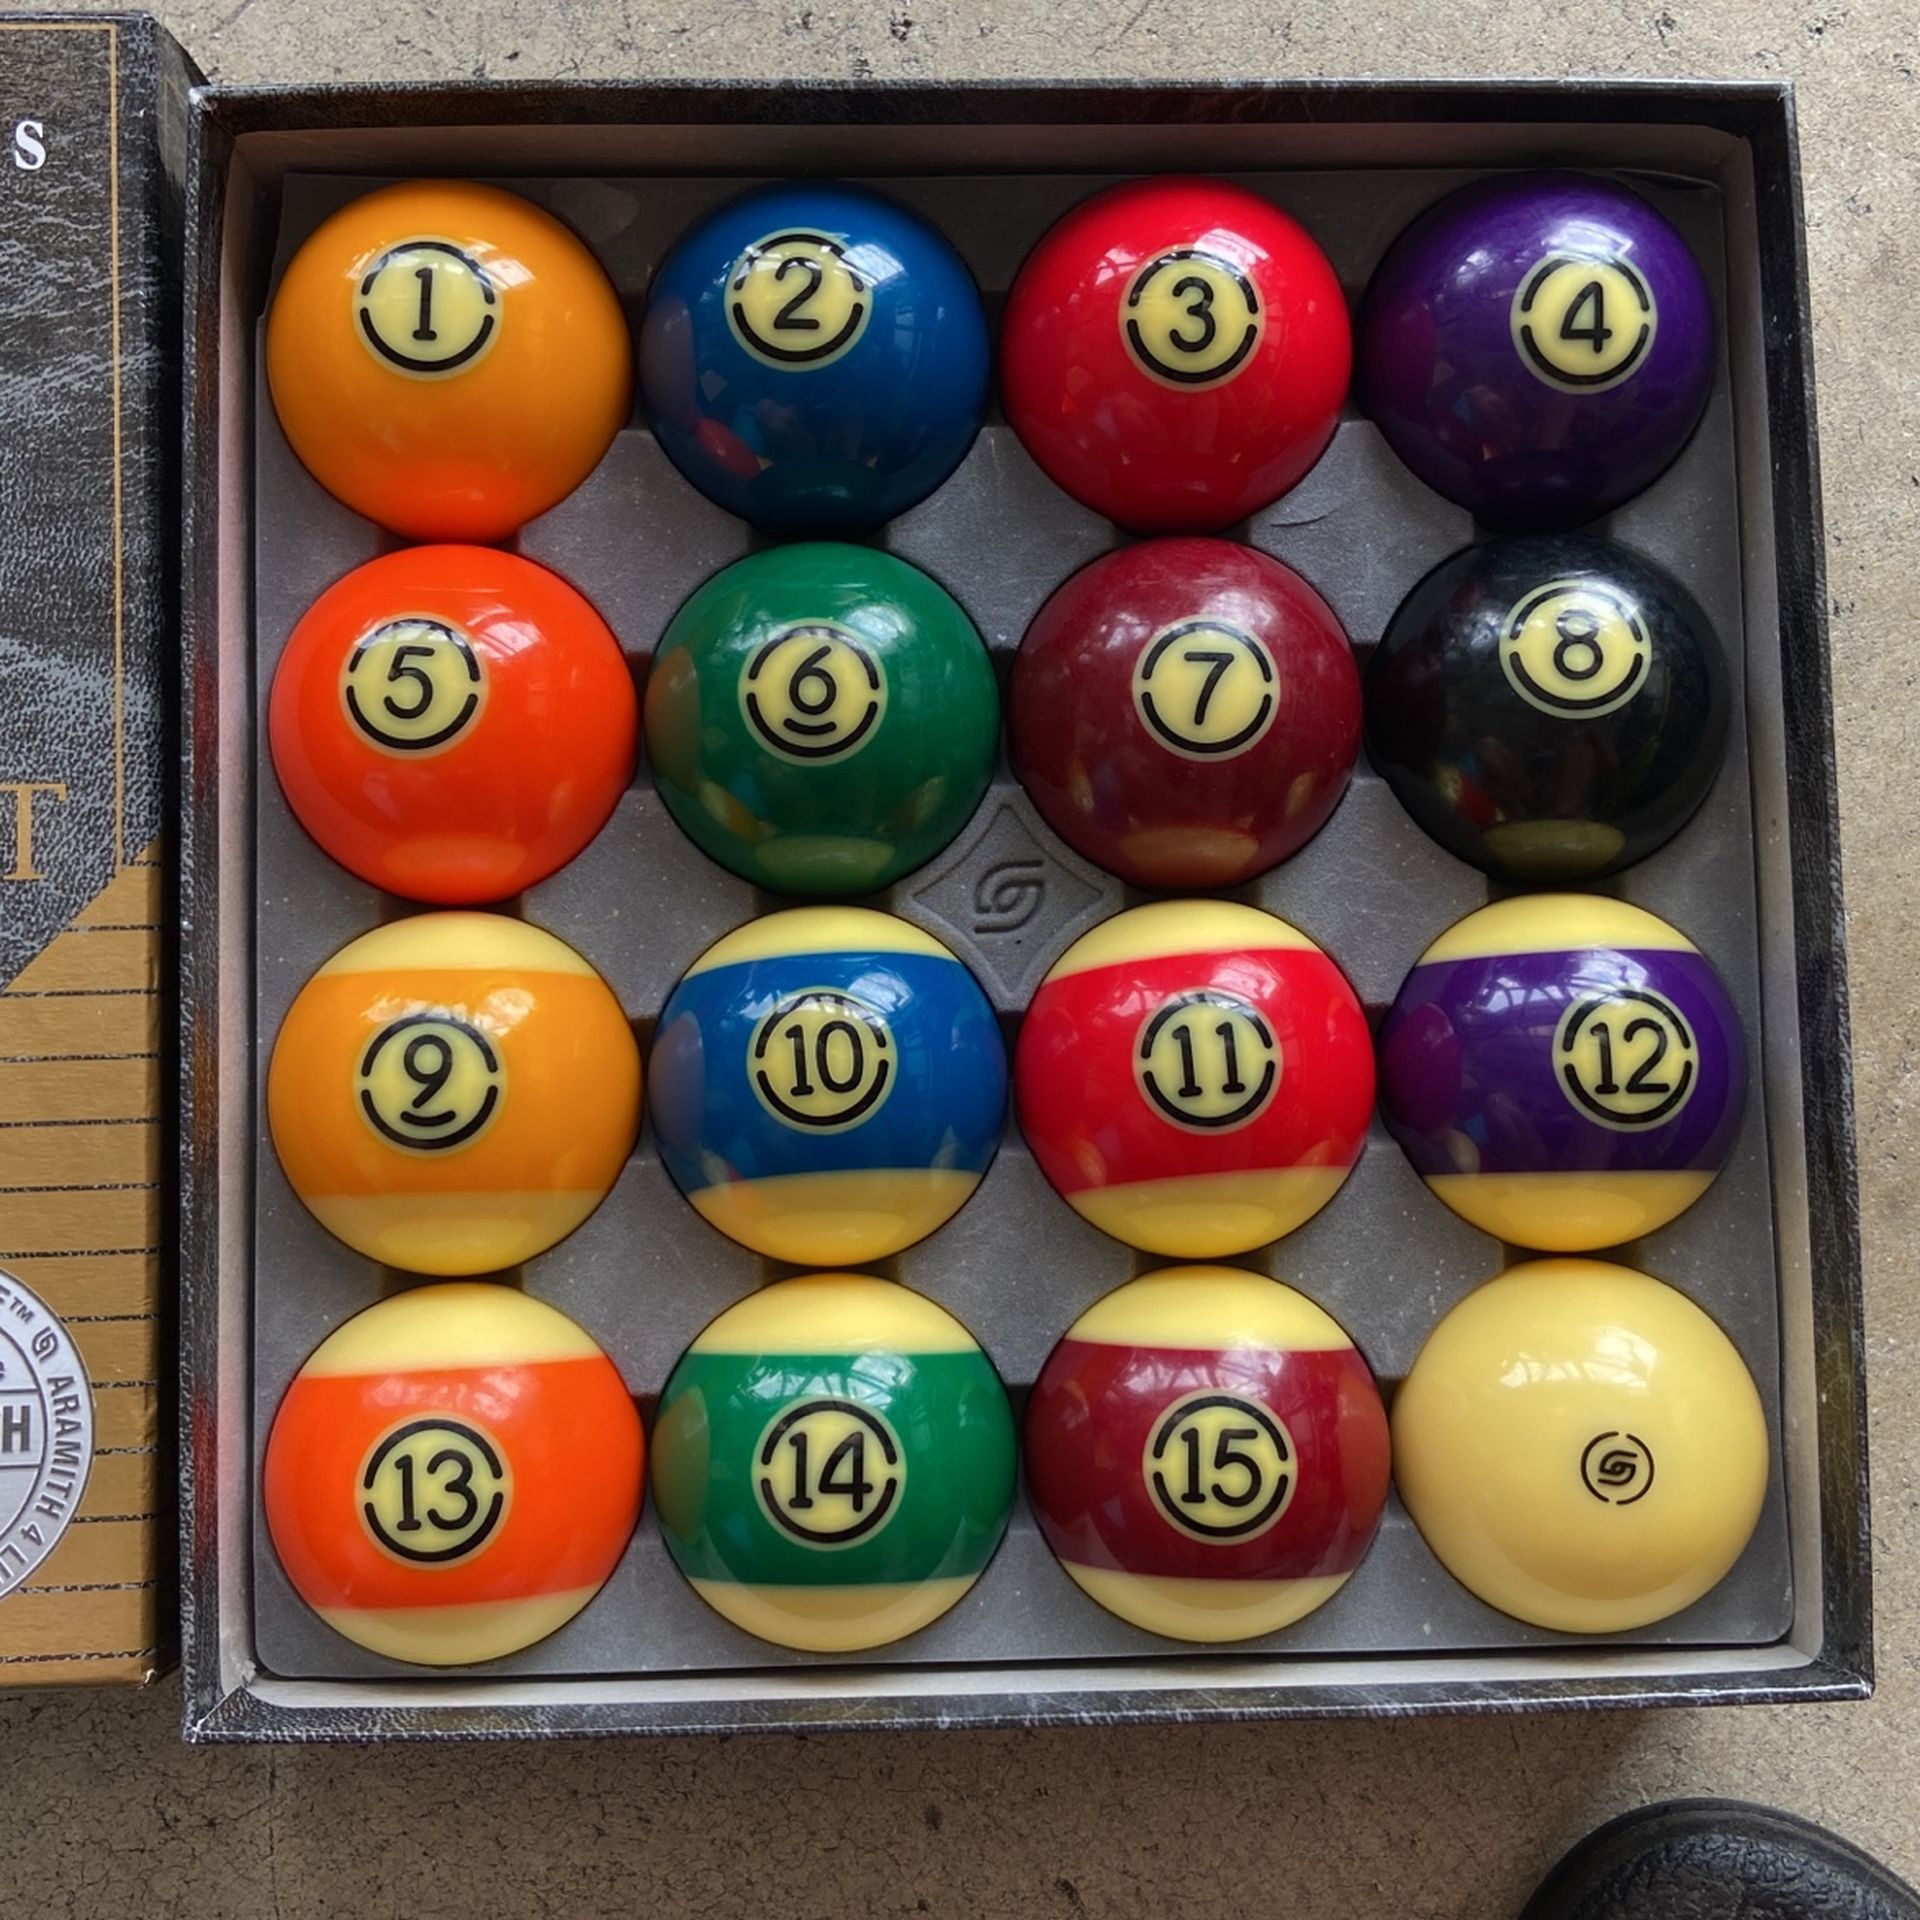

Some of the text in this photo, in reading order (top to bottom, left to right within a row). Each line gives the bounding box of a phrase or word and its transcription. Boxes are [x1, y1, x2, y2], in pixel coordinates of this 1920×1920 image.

[15, 121, 46, 170] S
[411, 267, 438, 341] 1
[773, 257, 823, 331] 2
[1168, 276, 1216, 352] 3
[1559, 282, 1613, 354] 4
[1553, 608, 1604, 682] 8
[384, 646, 435, 719] 5
[789, 646, 838, 719] 6
[1184, 652, 1235, 726] 7
[402, 1034, 454, 1108] 9
[785, 1021, 865, 1097] 10
[1171, 1022, 1247, 1099] 11
[1596, 1018, 1670, 1095] 12
[36, 1376, 82, 1519] ARAMITH
[789, 1431, 873, 1512] 14
[1181, 1428, 1263, 1508] 15
[394, 1449, 479, 1531] 13
[21, 1523, 42, 1546] 4
